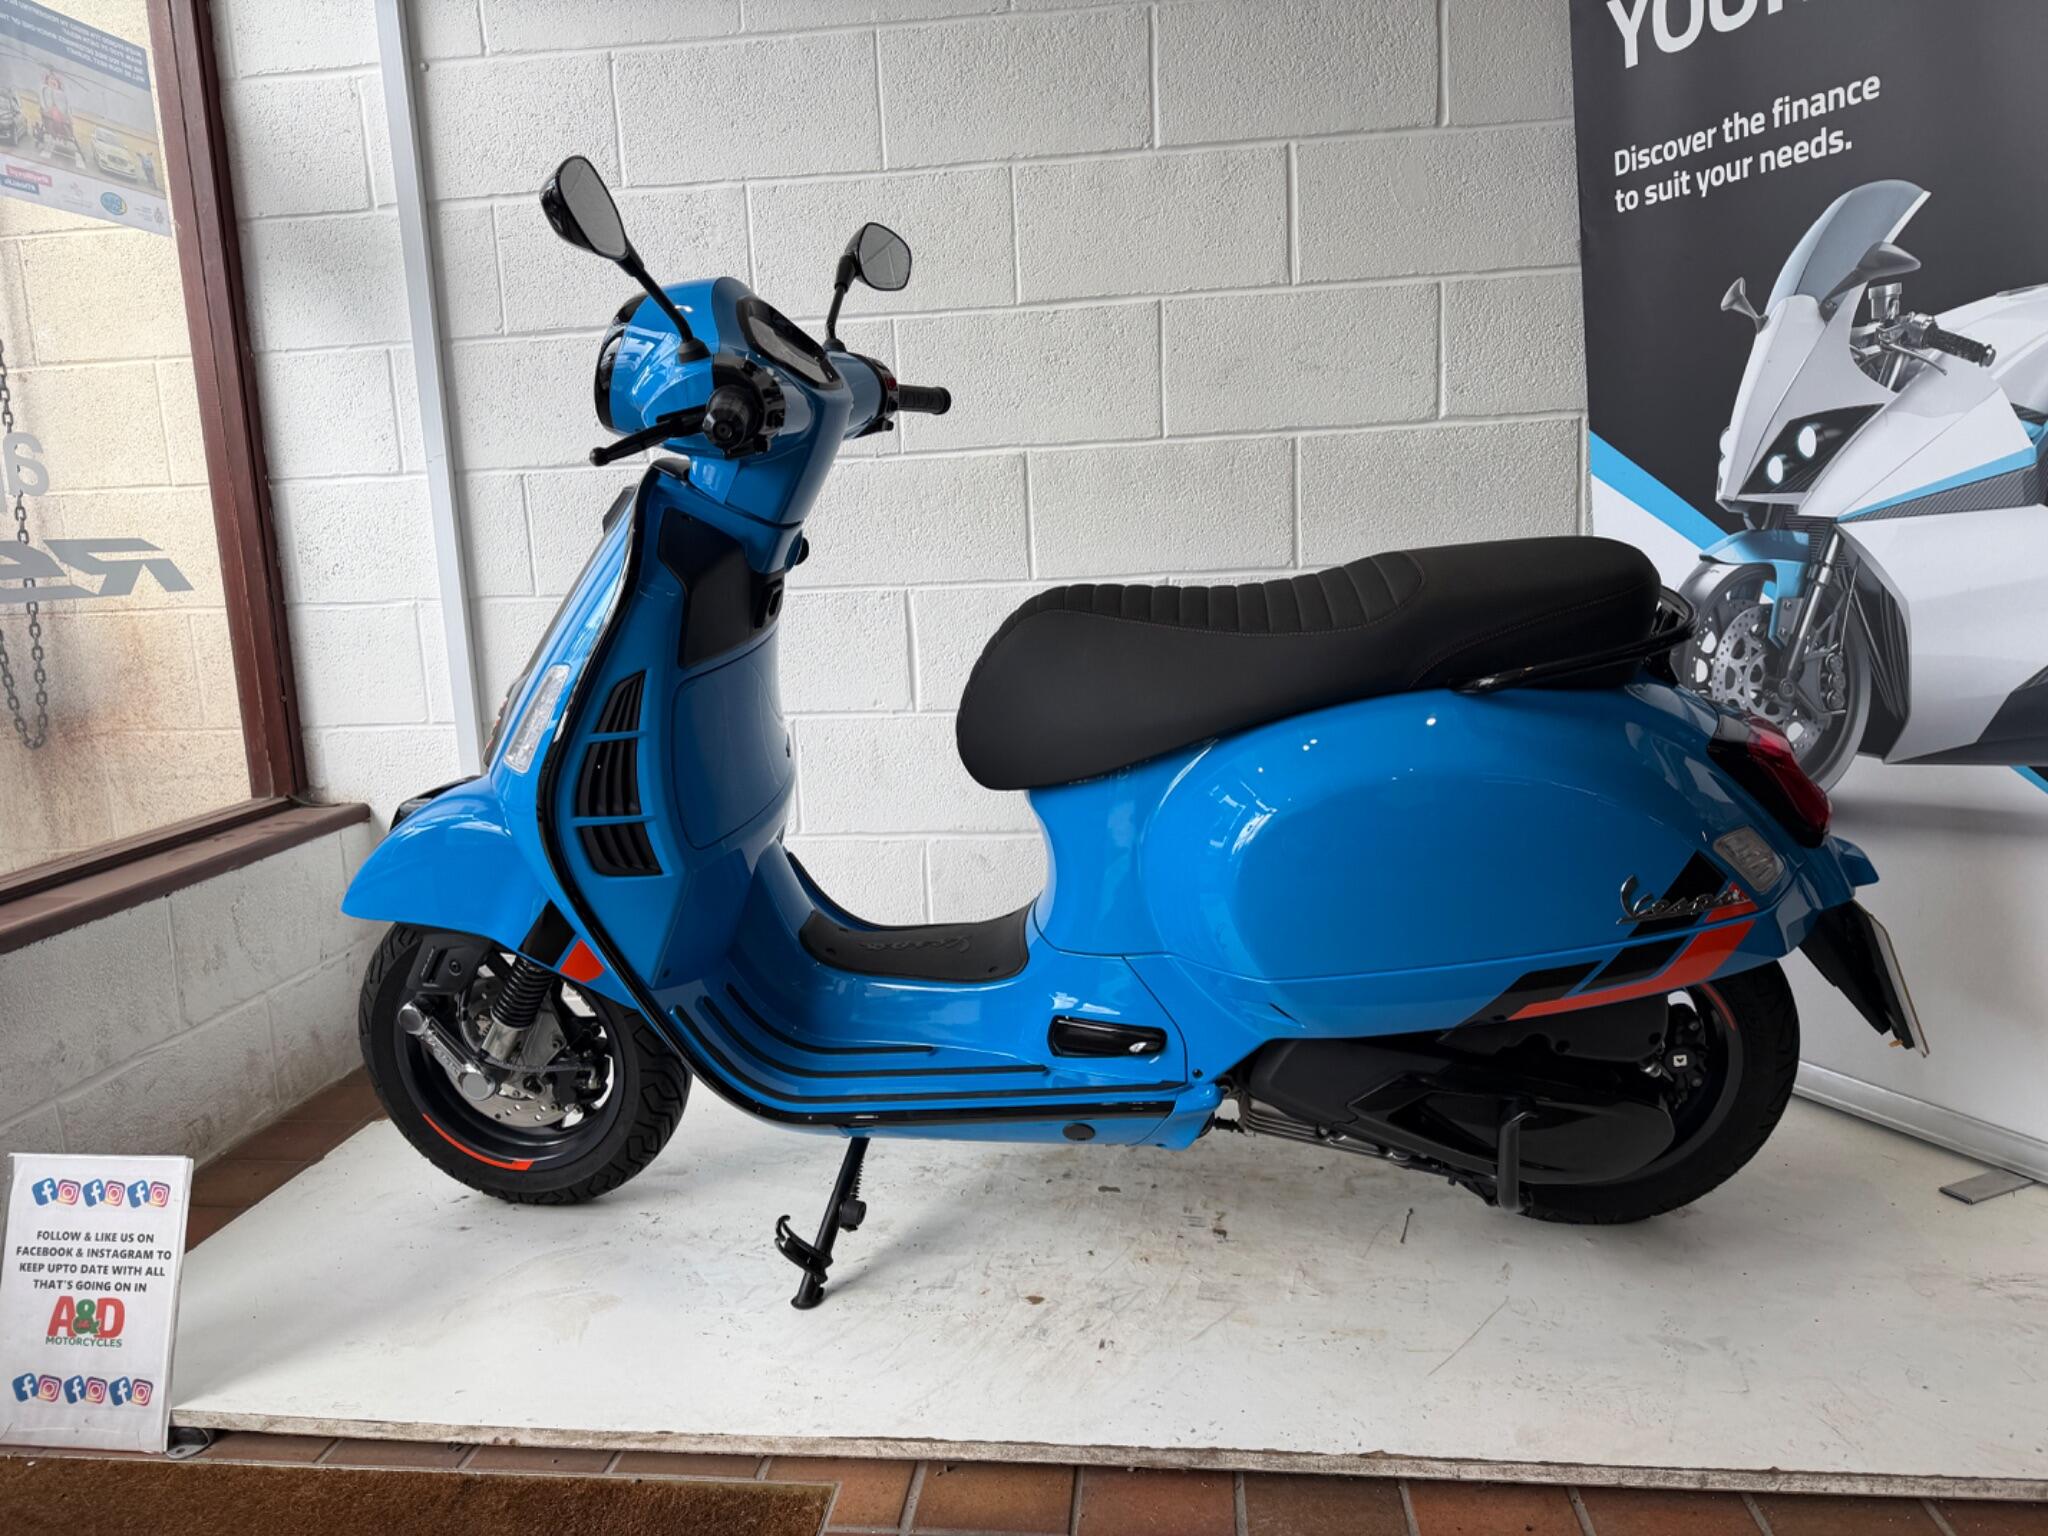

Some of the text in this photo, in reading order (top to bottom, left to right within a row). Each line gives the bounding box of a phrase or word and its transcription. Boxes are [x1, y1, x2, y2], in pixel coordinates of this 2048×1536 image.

[1606, 0, 1805, 68] YO
[1614, 75, 1881, 176] Discover the finance
[1614, 126, 1853, 213] to suit your needs.
[36, 1230, 154, 1243] FOLLOW & LIKE US ON
[16, 1246, 172, 1260] FACEBOOK & INSTAGRAM TO
[19, 1263, 166, 1276] KEEP UPTO DATE WITH ALL
[33, 1279, 147, 1292] THAT'S GOING ON IN
[47, 1295, 125, 1339] A&D
[45, 1336, 122, 1348] MOTORCYCLES
